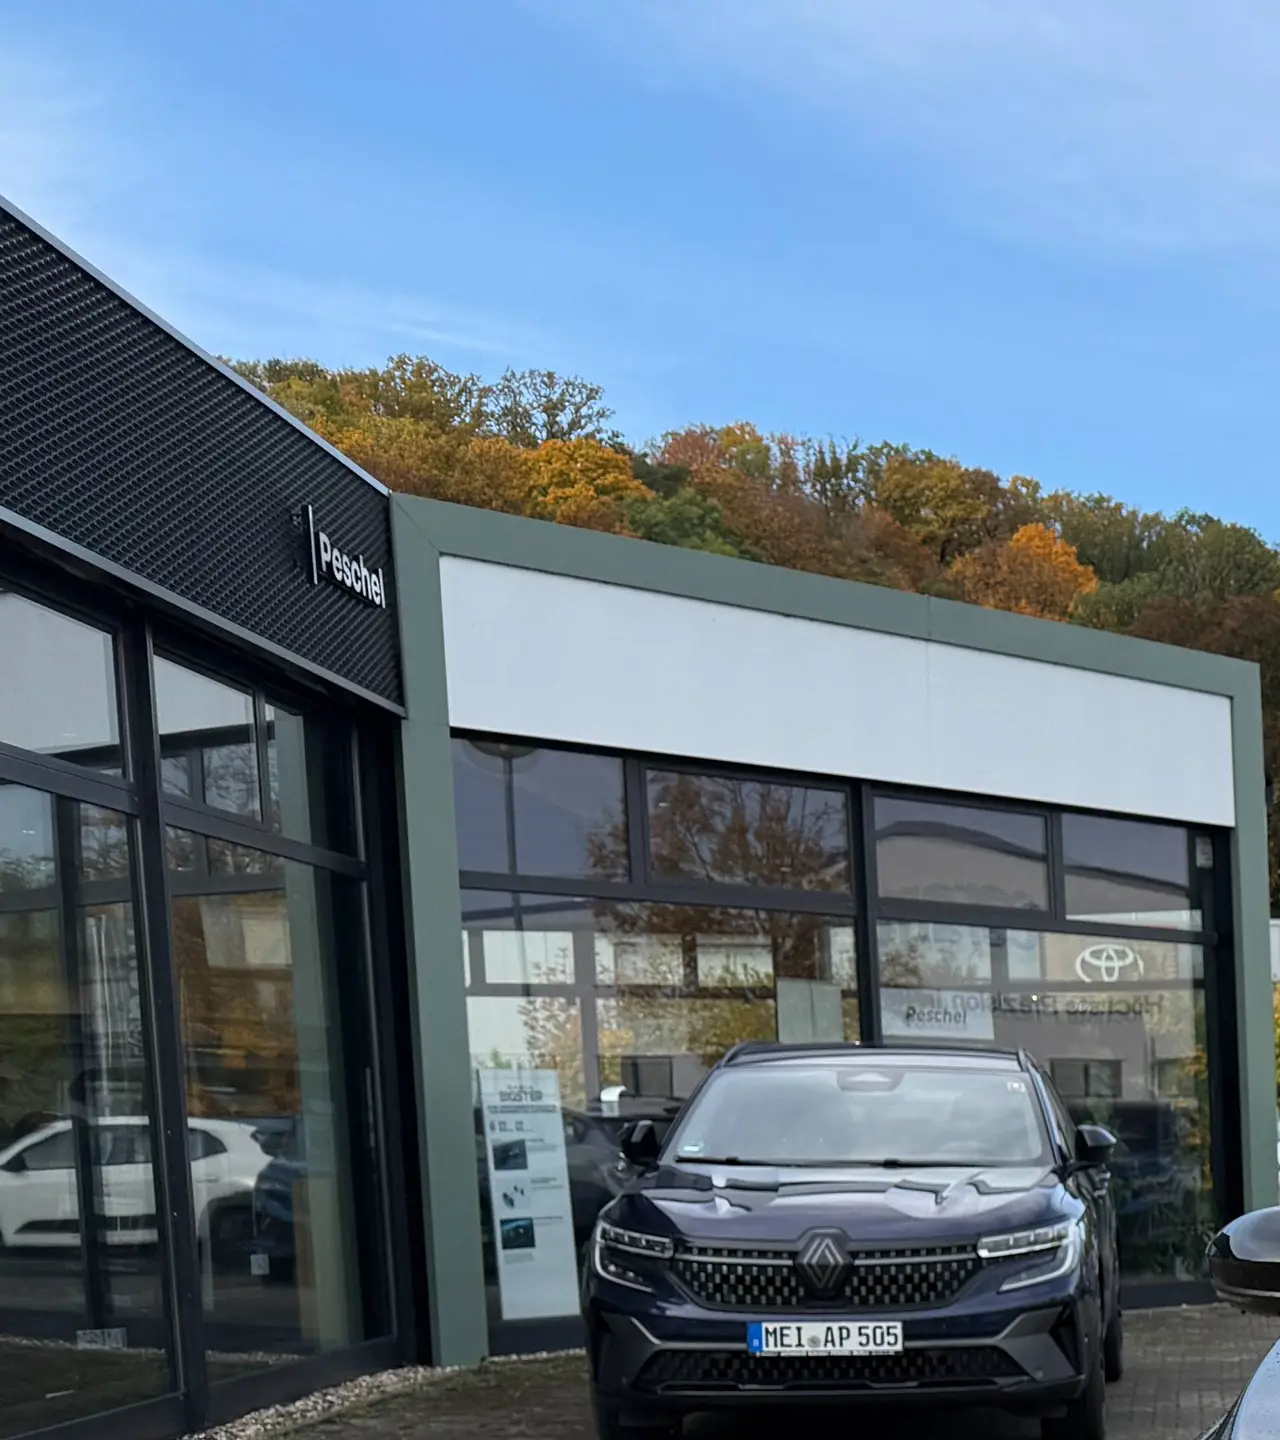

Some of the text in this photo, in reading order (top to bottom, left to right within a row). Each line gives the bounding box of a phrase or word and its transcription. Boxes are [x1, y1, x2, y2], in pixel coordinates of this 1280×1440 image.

[319, 531, 386, 609] Peschel
[905, 1005, 967, 1025] Peschel
[764, 1325, 899, 1348] MEI AP 505
